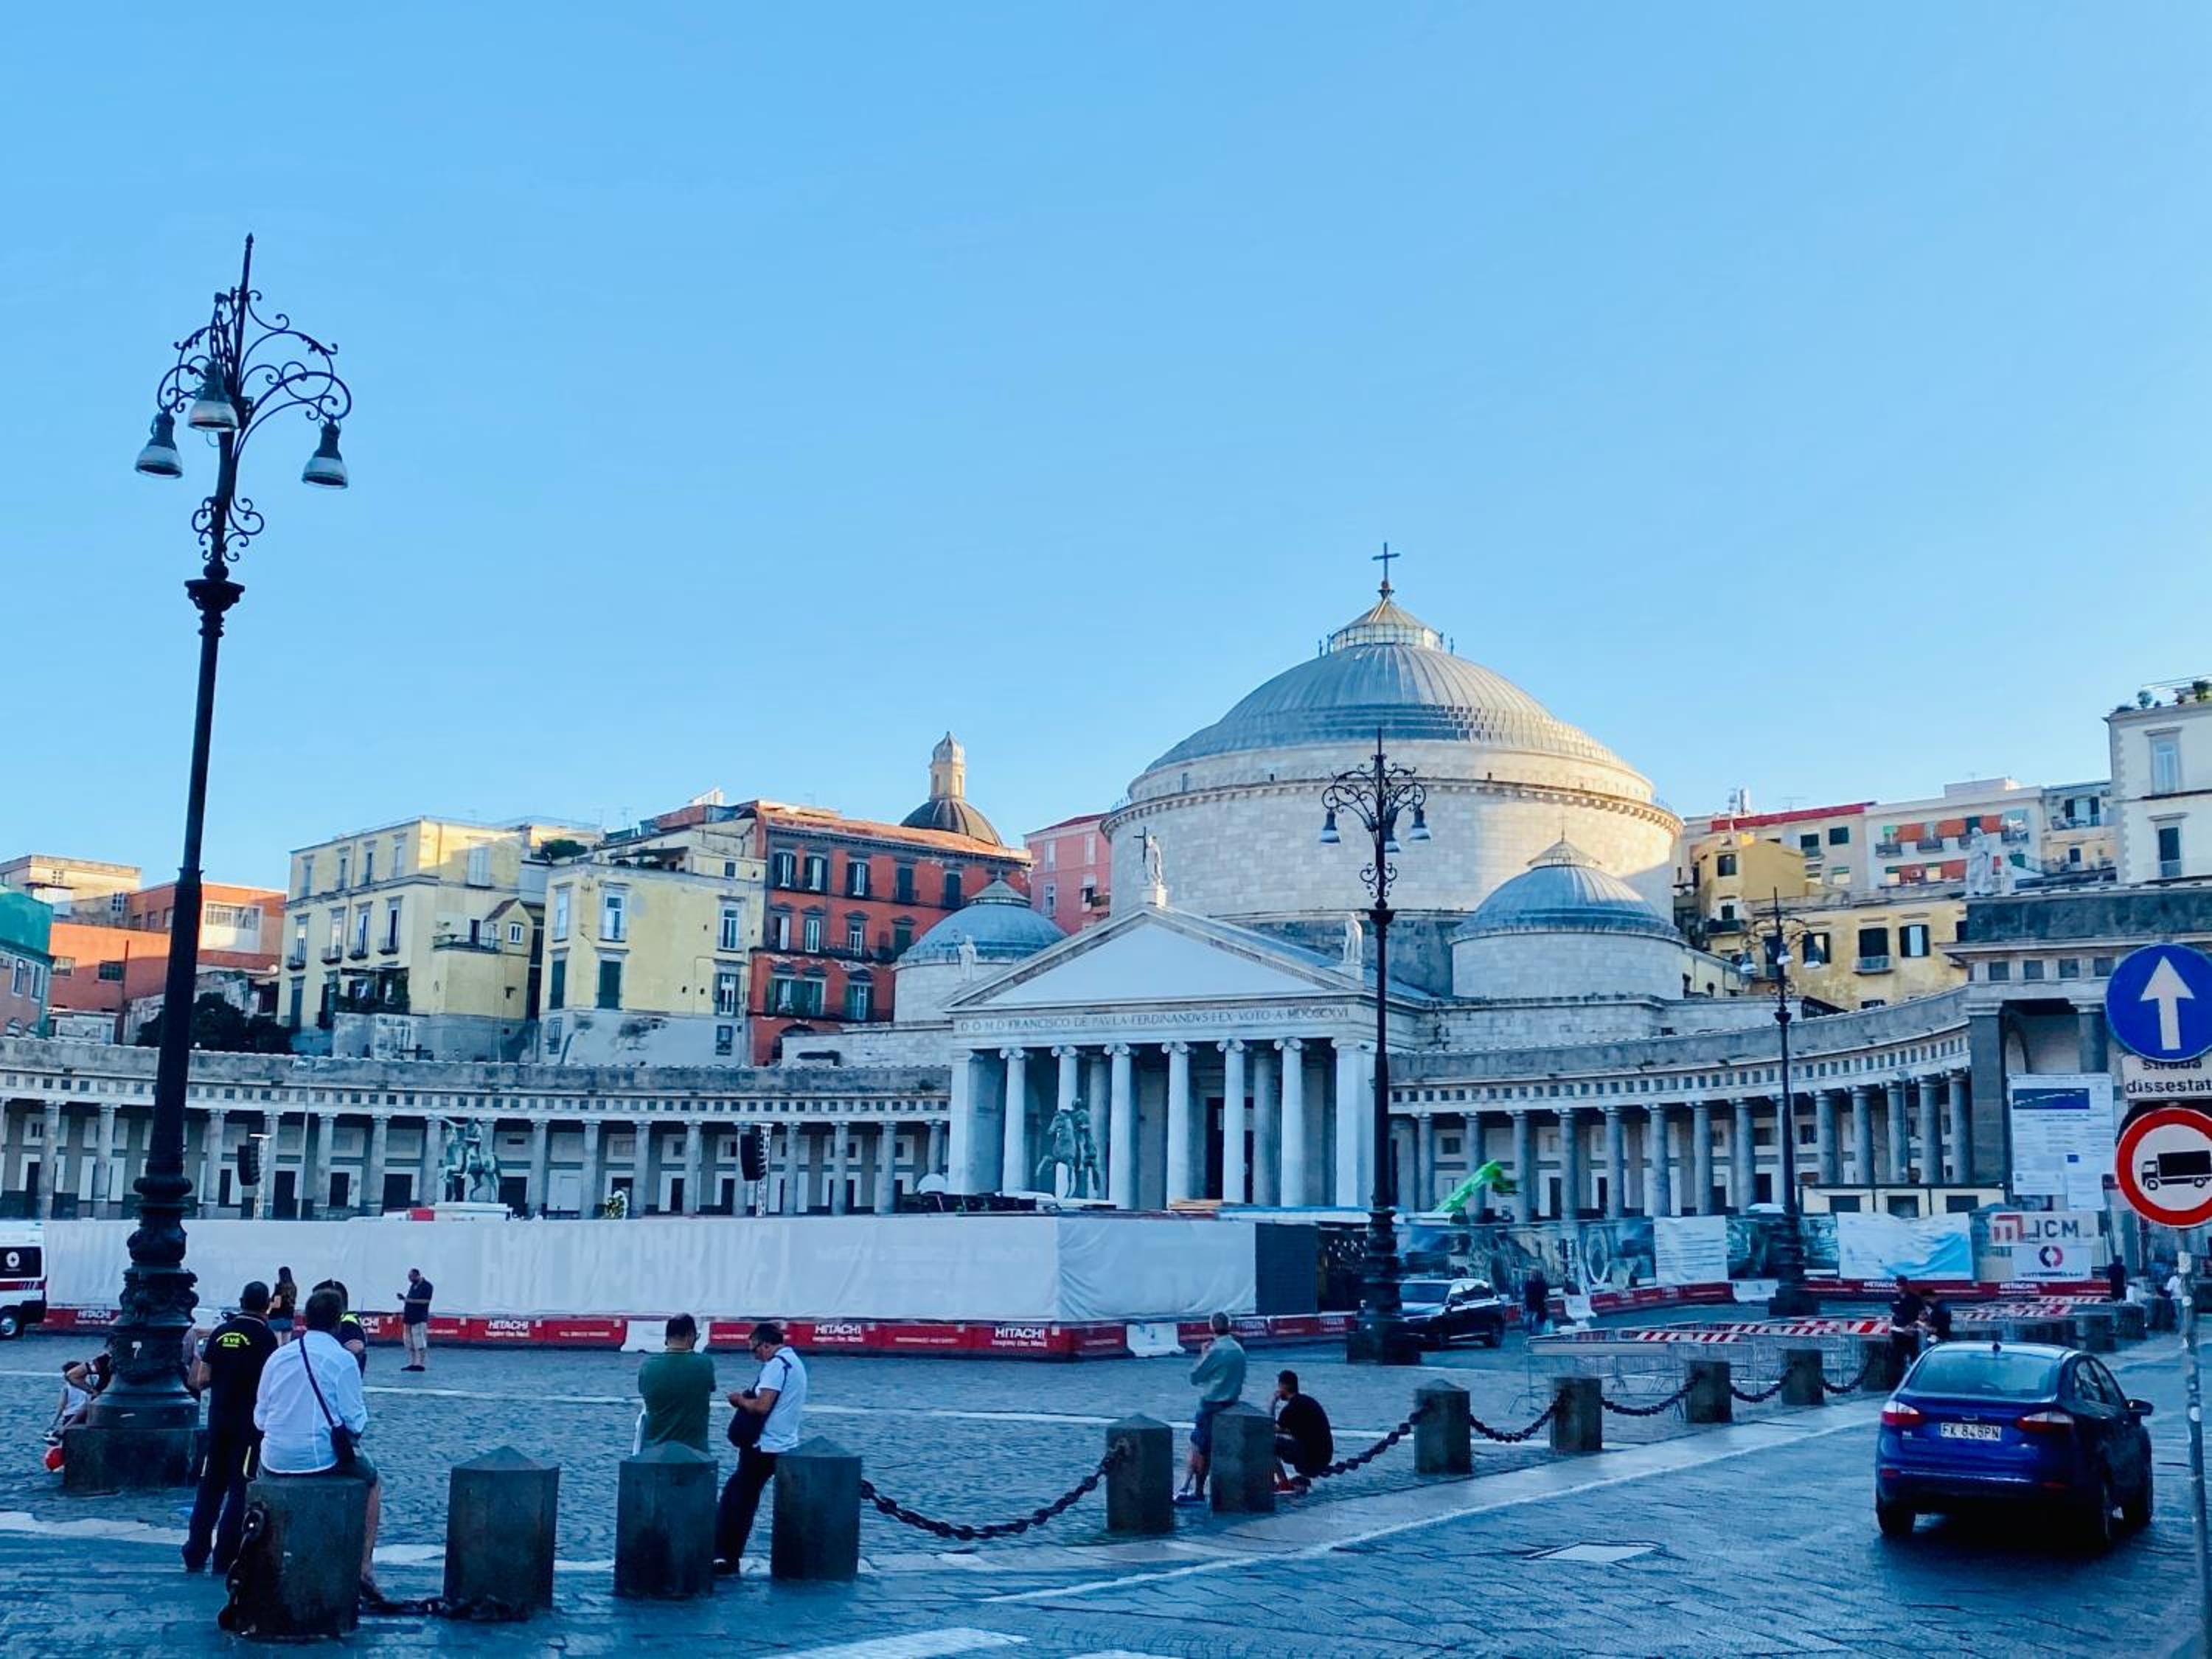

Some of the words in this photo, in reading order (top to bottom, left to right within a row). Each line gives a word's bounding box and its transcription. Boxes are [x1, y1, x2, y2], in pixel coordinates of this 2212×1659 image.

[1009, 1017, 1071, 1029] FRANCISCO
[1074, 1016, 1086, 1027] DE
[489, 1321, 529, 1330] HITACHI
[815, 1324, 861, 1335] HITACHI
[995, 1327, 1045, 1339] HITACHI
